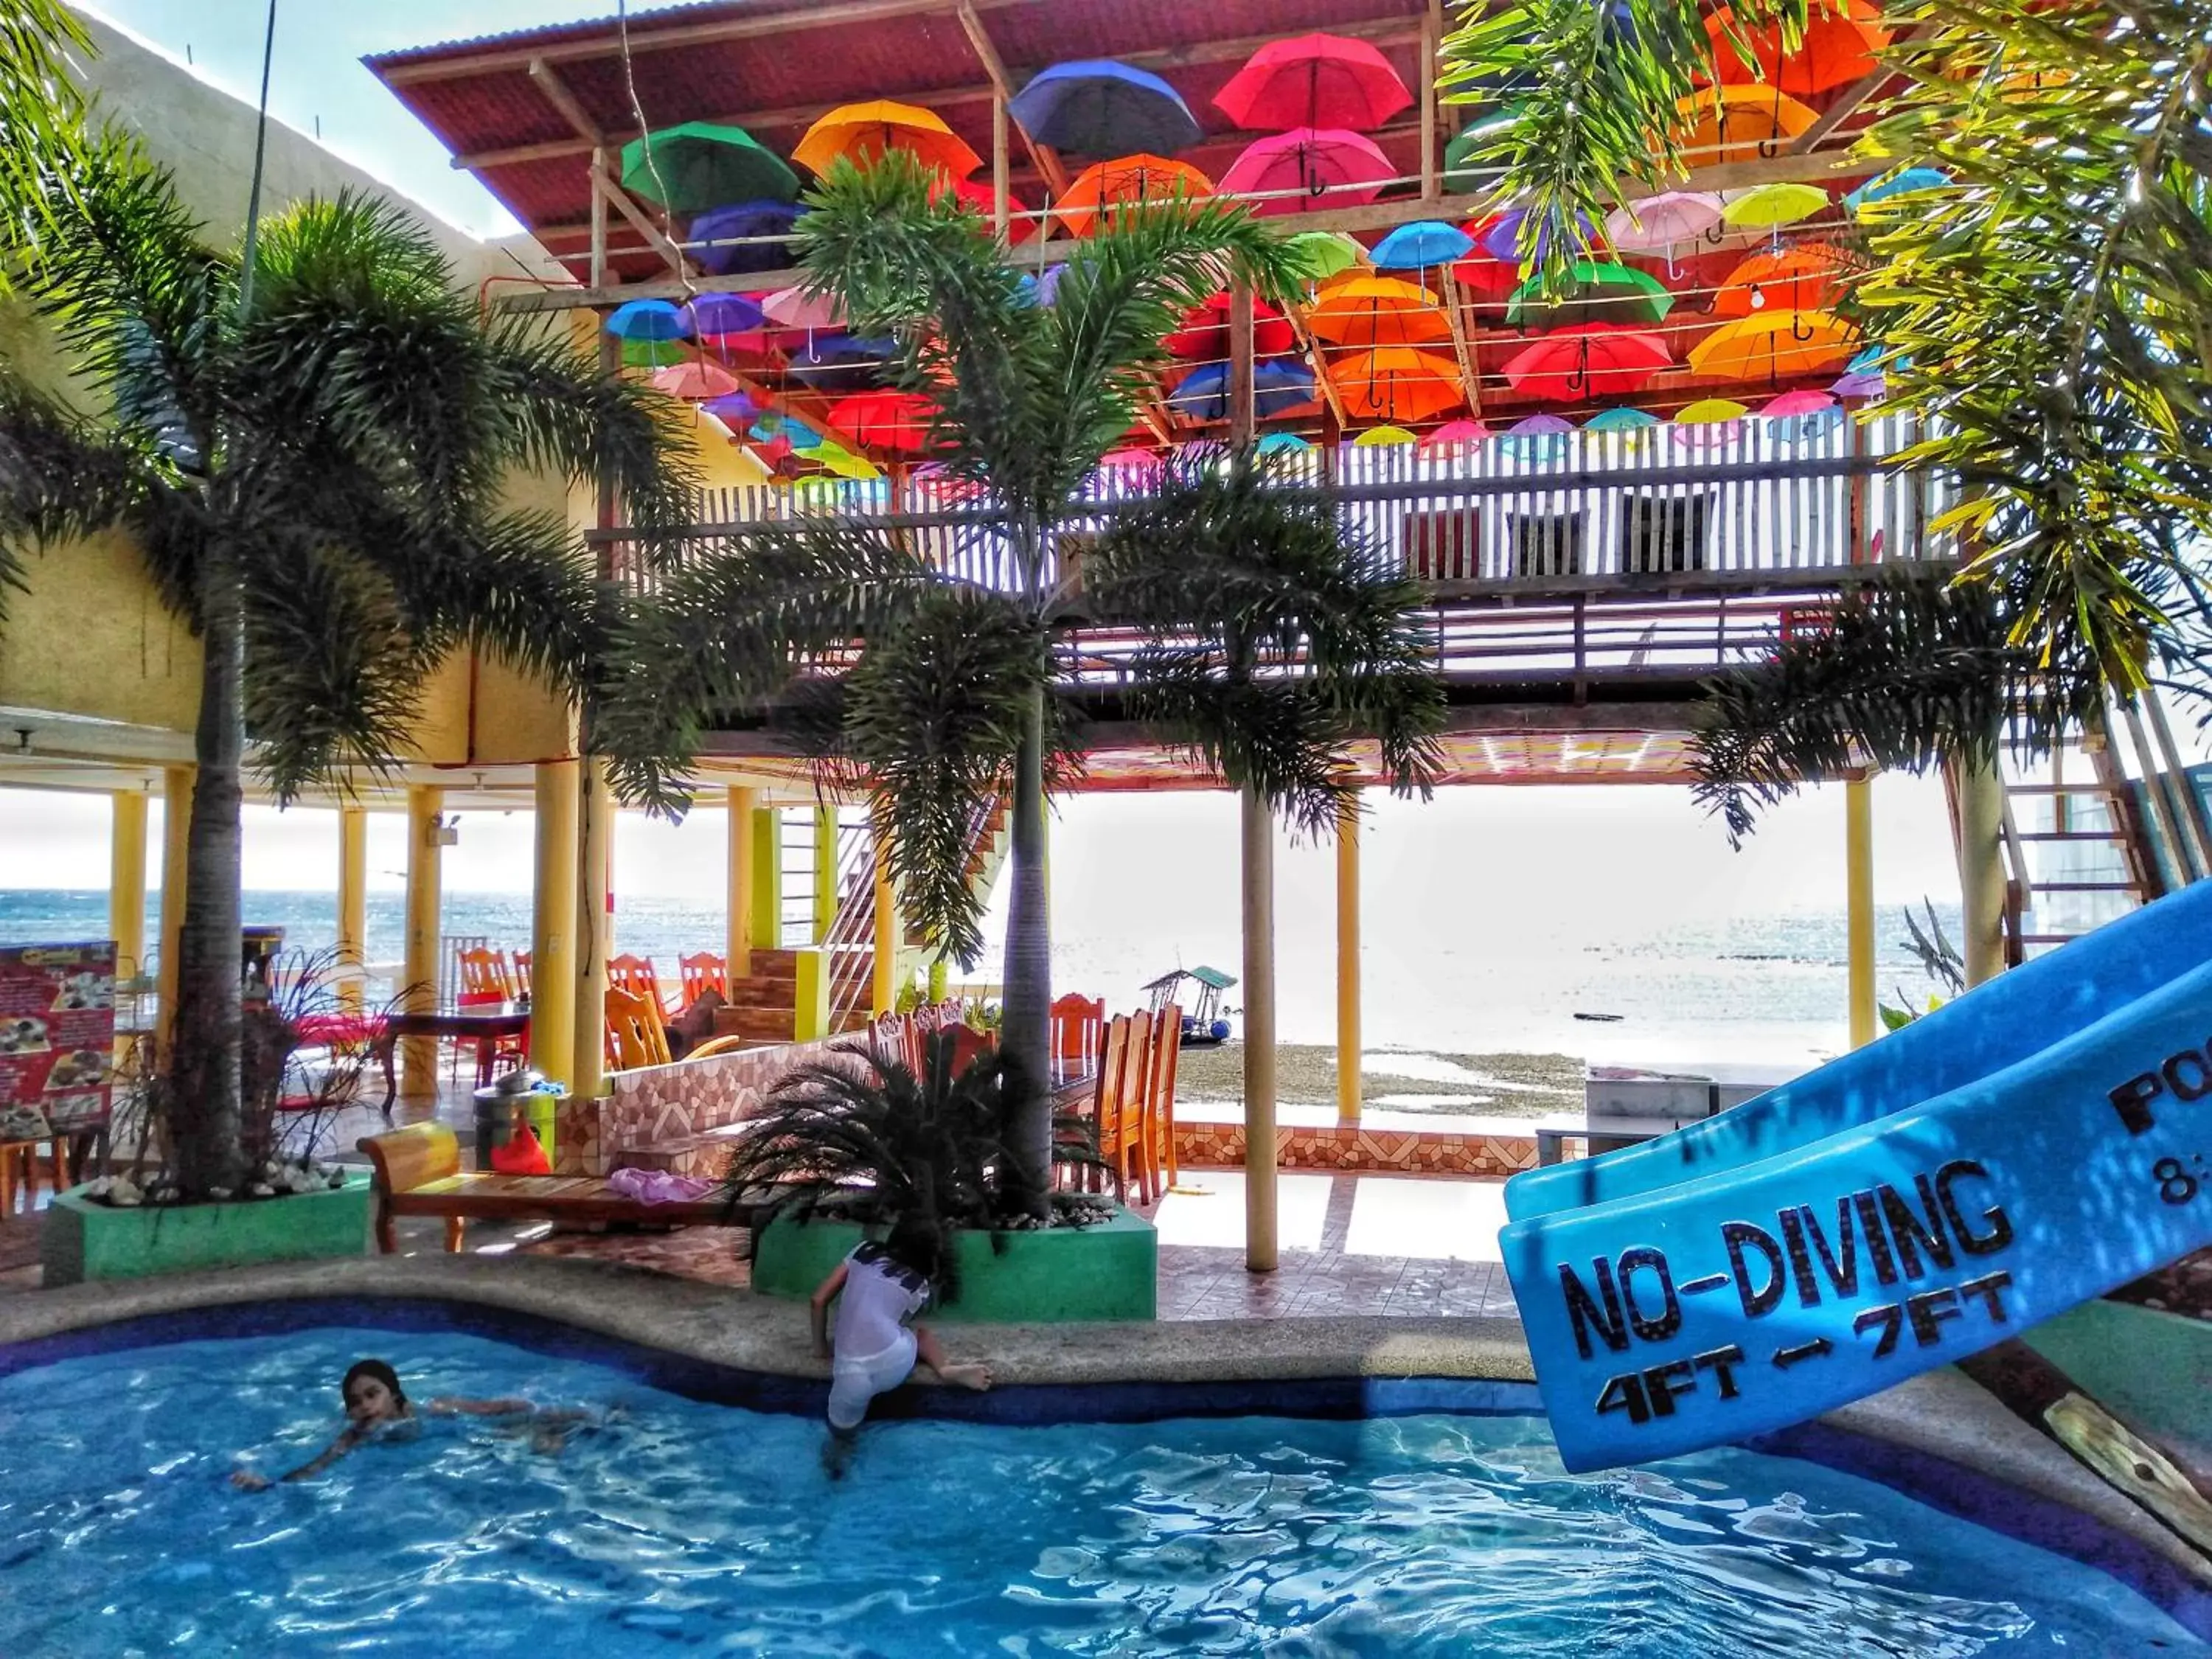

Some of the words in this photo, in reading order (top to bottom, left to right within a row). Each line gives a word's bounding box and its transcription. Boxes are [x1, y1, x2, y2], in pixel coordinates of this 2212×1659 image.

[2109, 1036, 2212, 1137] PO
[1557, 1158, 2014, 1360] NO-DIVING
[1596, 1344, 1745, 1425] 4FT
[1854, 1271, 2013, 1360] 7FT
